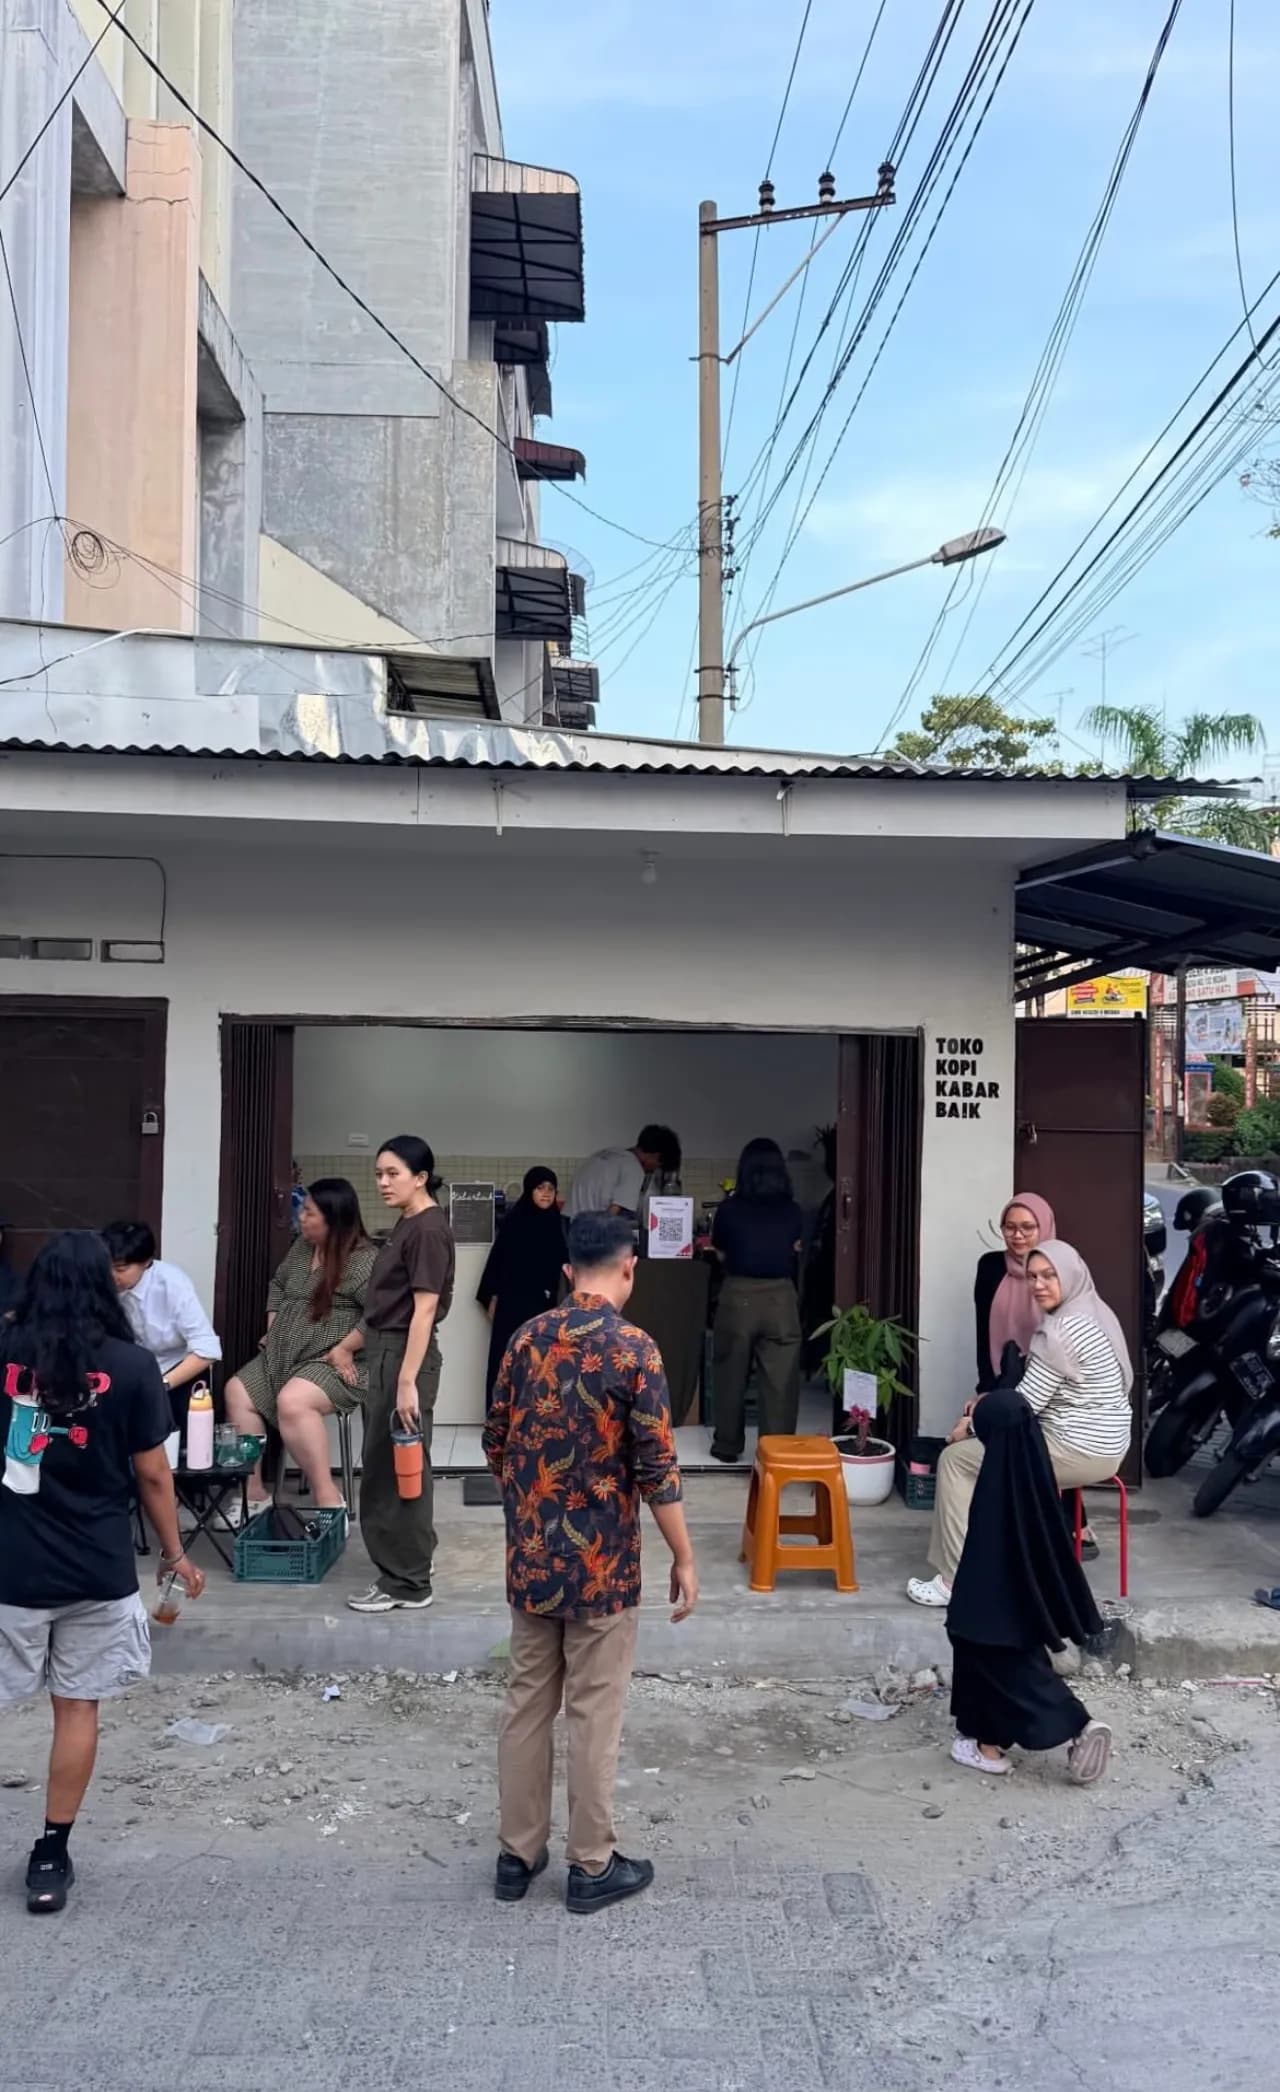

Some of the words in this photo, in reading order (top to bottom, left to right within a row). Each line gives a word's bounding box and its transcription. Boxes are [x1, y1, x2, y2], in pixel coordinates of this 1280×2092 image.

[936, 1037, 984, 1055] TOKO
[936, 1059, 977, 1076] KOPI
[936, 1080, 1000, 1098] KABAR
